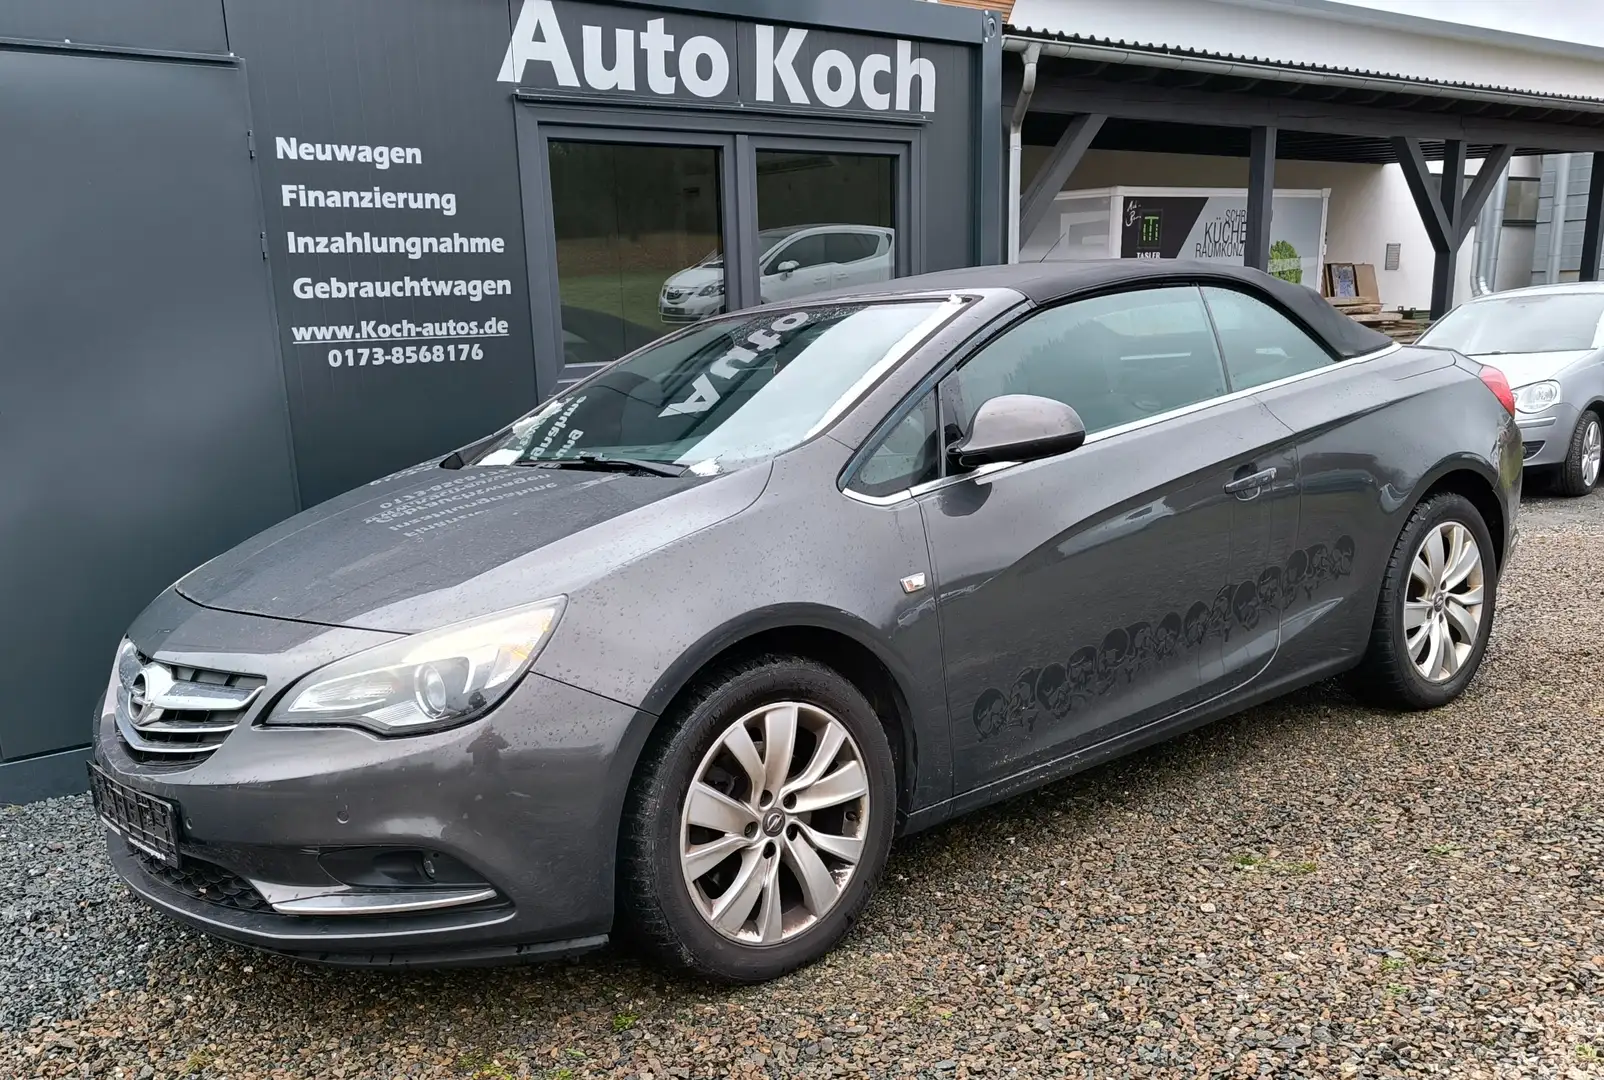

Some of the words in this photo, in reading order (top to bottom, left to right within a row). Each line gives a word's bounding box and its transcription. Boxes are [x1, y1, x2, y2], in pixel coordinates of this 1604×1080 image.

[497, 0, 730, 98] Auto
[755, 24, 936, 113] Koch
[275, 136, 423, 170] Neuwagen
[281, 184, 457, 216] Finanzierung
[286, 231, 505, 260] Inzahlungnahme
[292, 276, 512, 302] Gebrauchtwagen
[291, 317, 509, 342] www.Koch-autos.de
[327, 343, 484, 368] 0173-8568176
